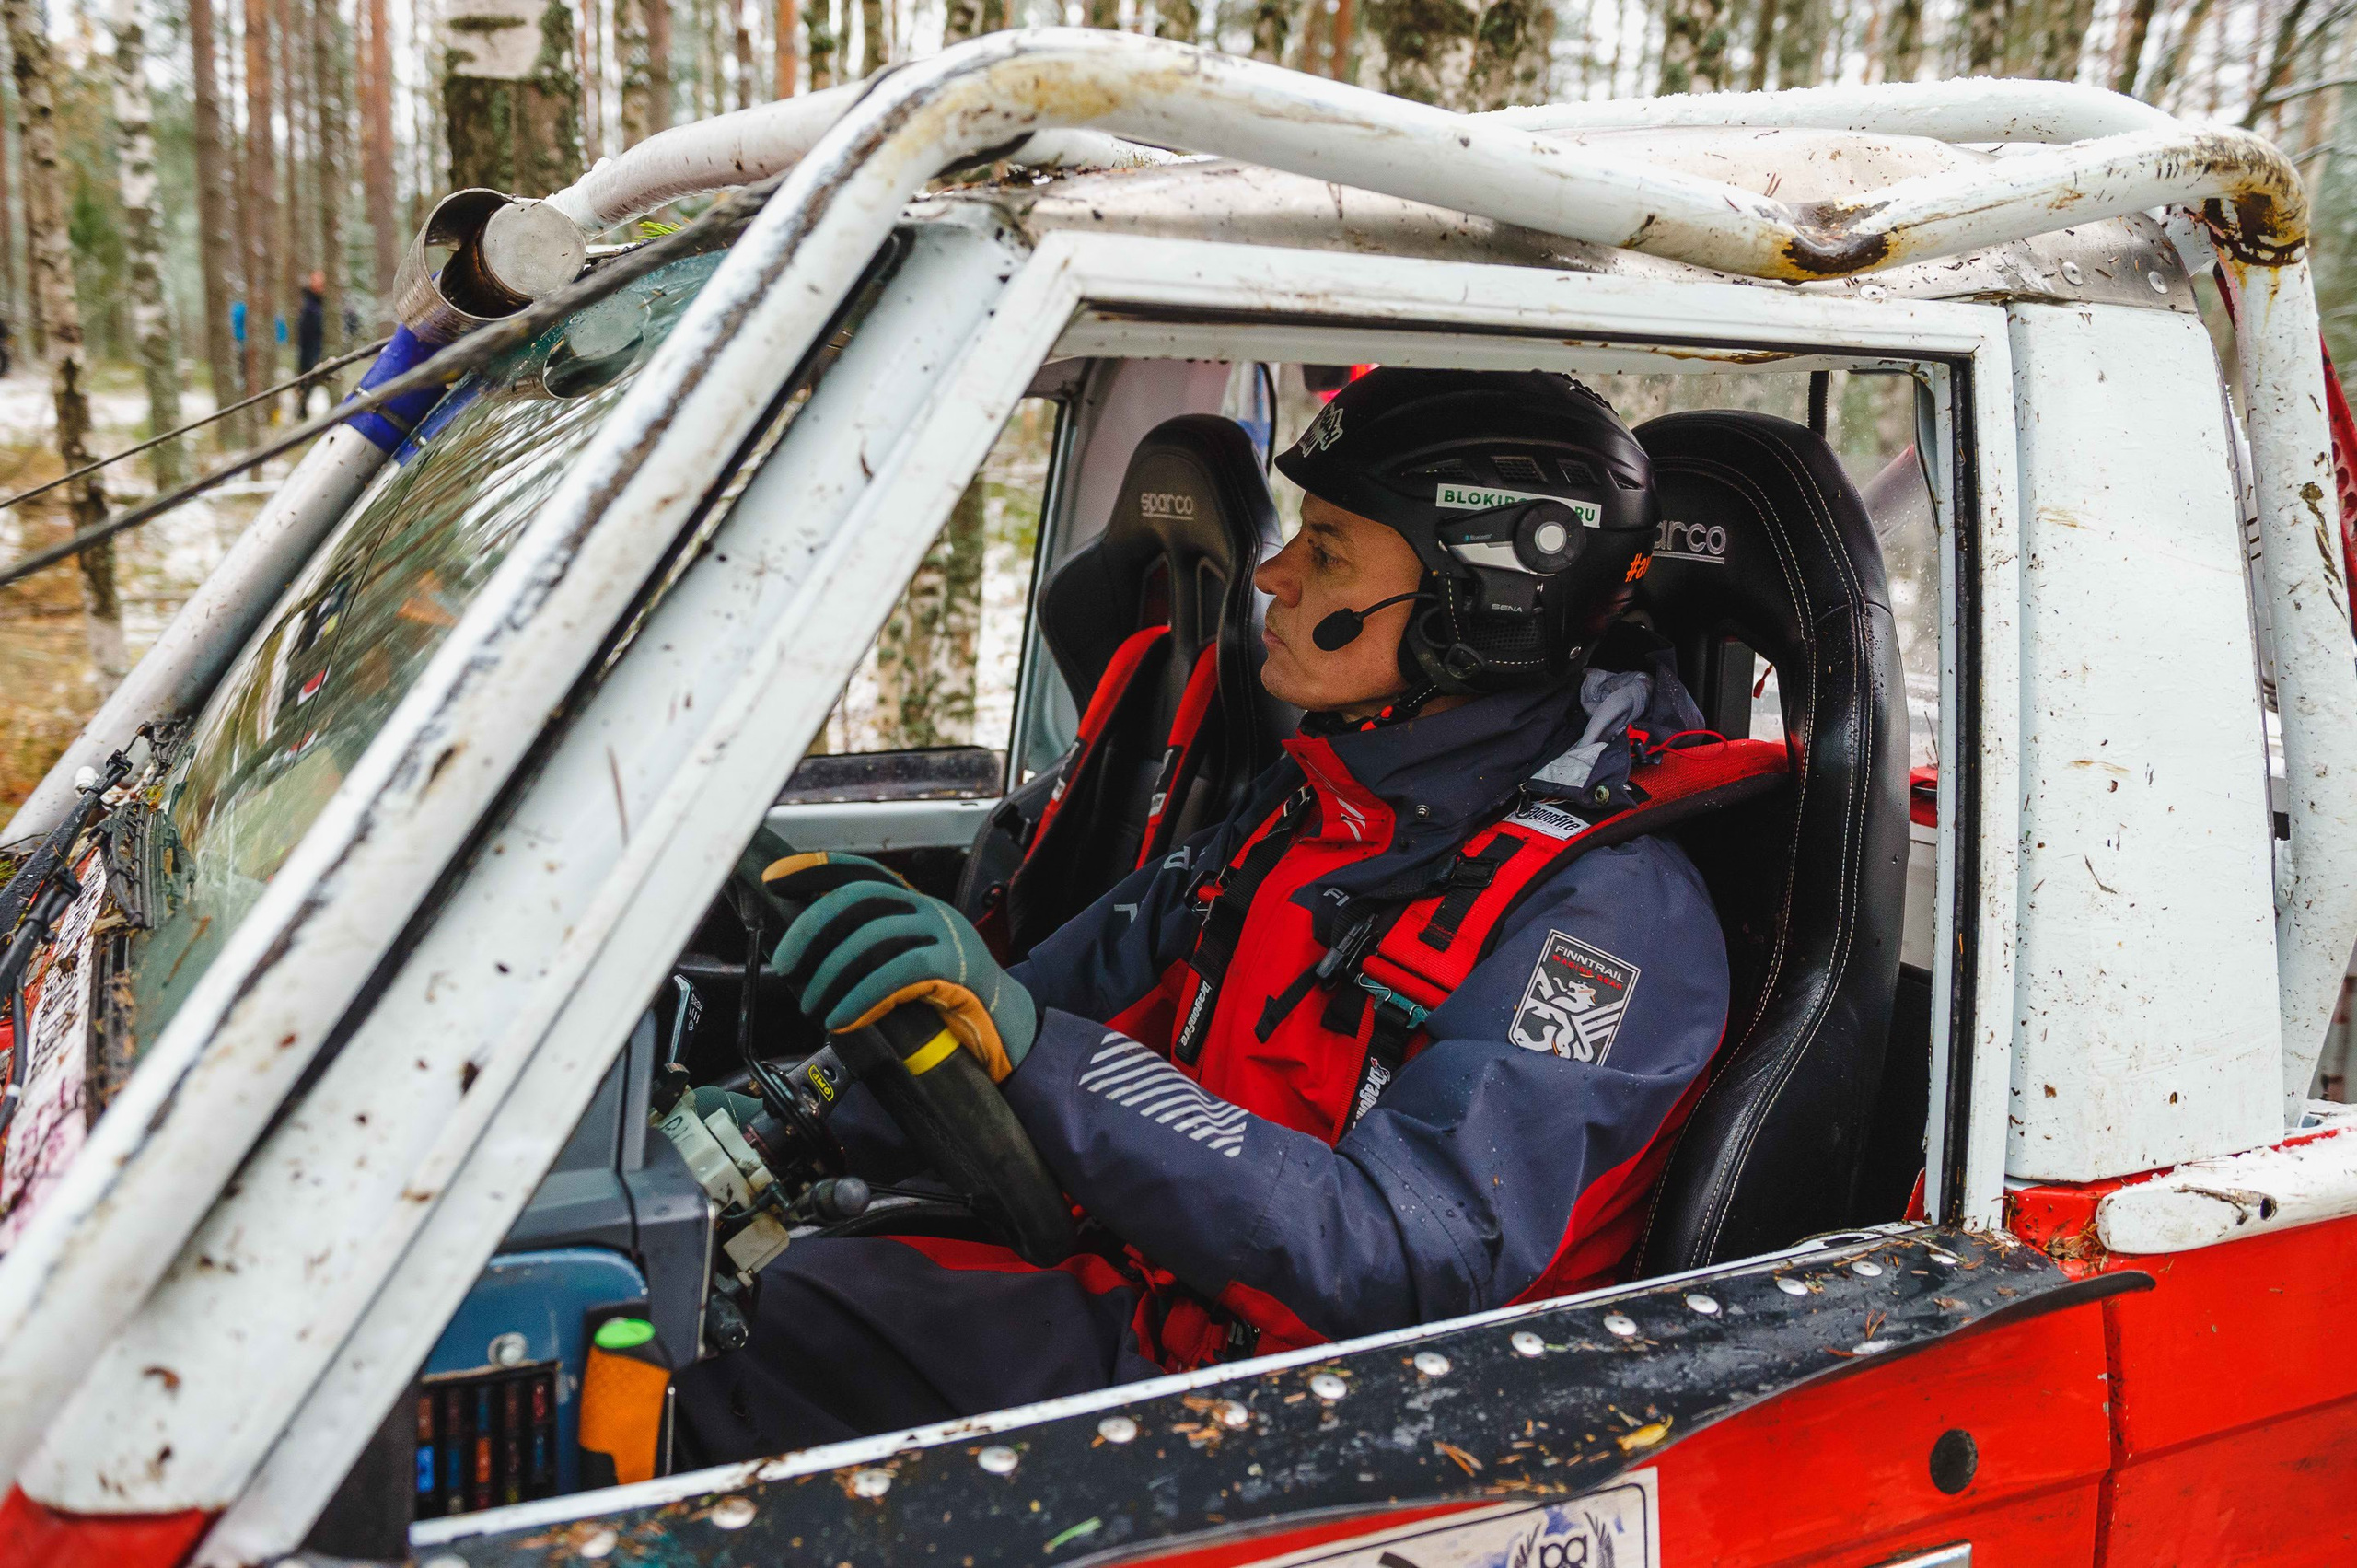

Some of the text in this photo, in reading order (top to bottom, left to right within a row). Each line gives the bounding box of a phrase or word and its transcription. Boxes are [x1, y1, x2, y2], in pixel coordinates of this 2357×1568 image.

[1141, 493, 1194, 516] sparco
[1492, 603, 1523, 613] SENA
[1554, 945, 1624, 983] FINNTRAIL
[812, 1073, 830, 1095] OMP
